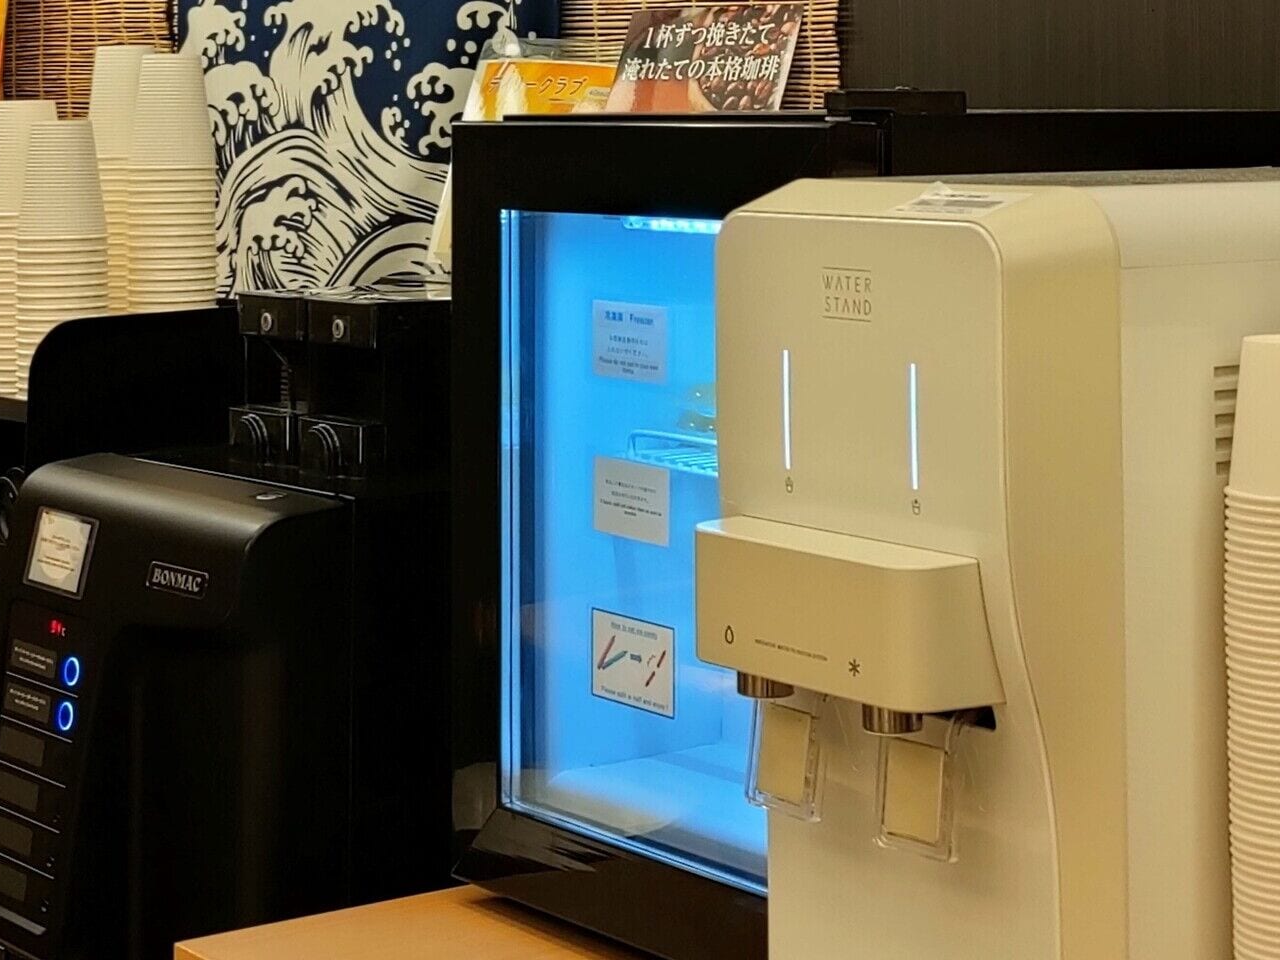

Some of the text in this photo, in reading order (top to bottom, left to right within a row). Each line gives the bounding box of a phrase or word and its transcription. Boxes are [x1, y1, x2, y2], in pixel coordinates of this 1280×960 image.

[643, 21, 776, 49] 1杯ずつ挽きたて
[621, 54, 781, 81] 淹れたての本格珈琲
[822, 275, 871, 292] WATER
[825, 296, 871, 315] STAND
[152, 568, 201, 592] BONMAC
